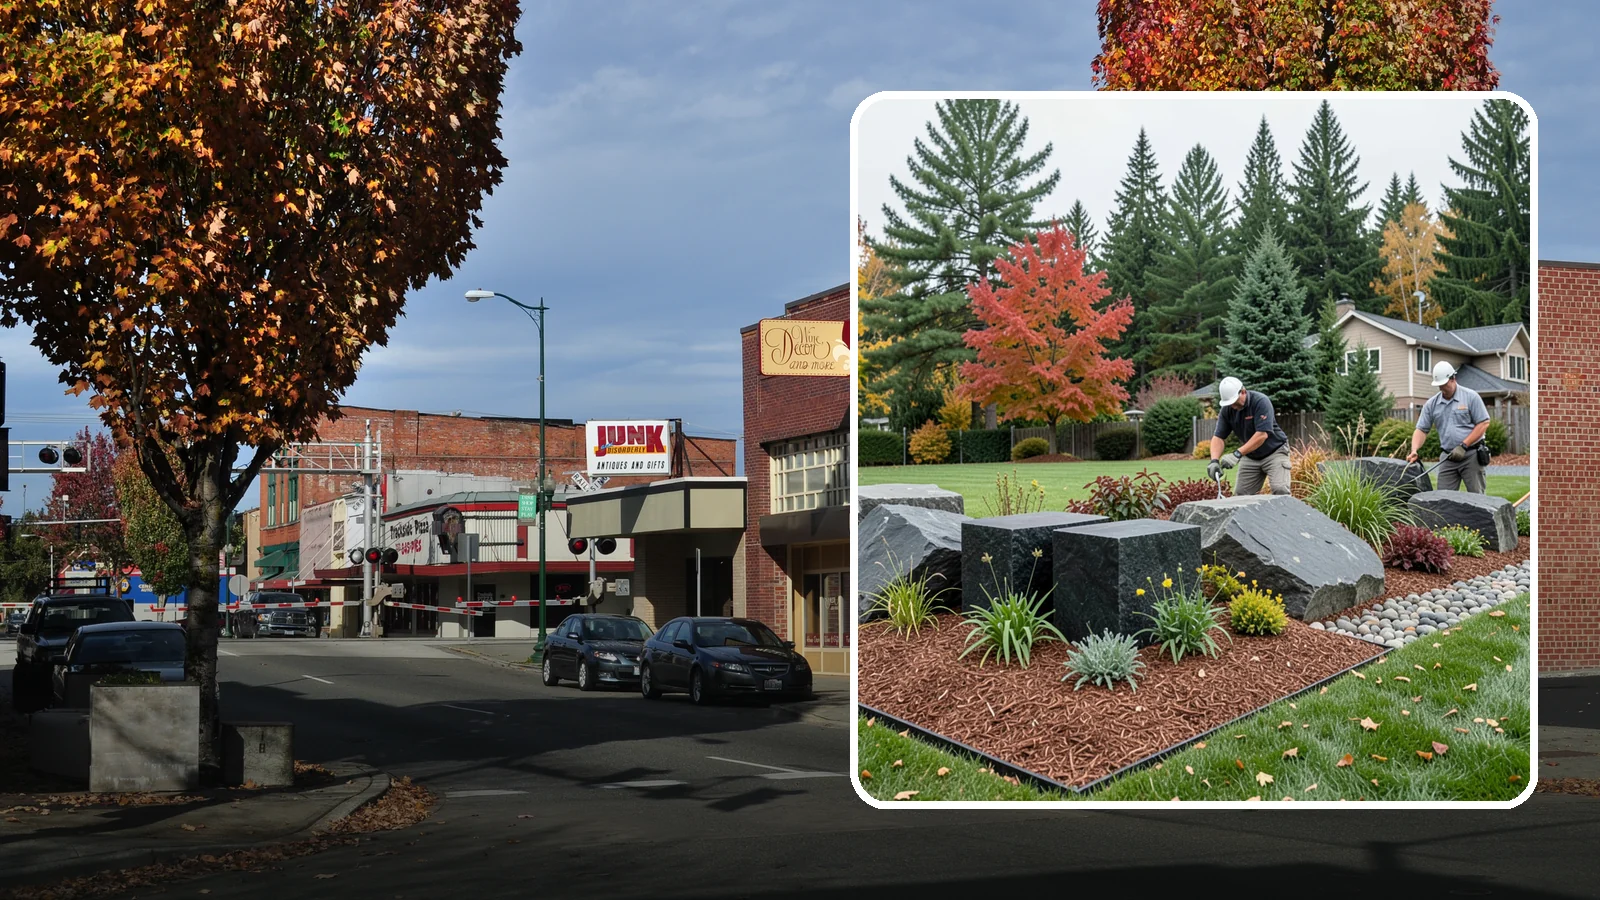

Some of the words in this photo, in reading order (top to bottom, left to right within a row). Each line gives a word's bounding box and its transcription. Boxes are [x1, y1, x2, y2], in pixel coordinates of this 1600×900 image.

[595, 425, 665, 457] JUNK
[607, 446, 646, 454] DISORDERLY
[597, 461, 628, 470] ANTIQUES
[631, 461, 644, 470] AND
[647, 461, 665, 469] GIFTS
[414, 520, 429, 535] Pizza
